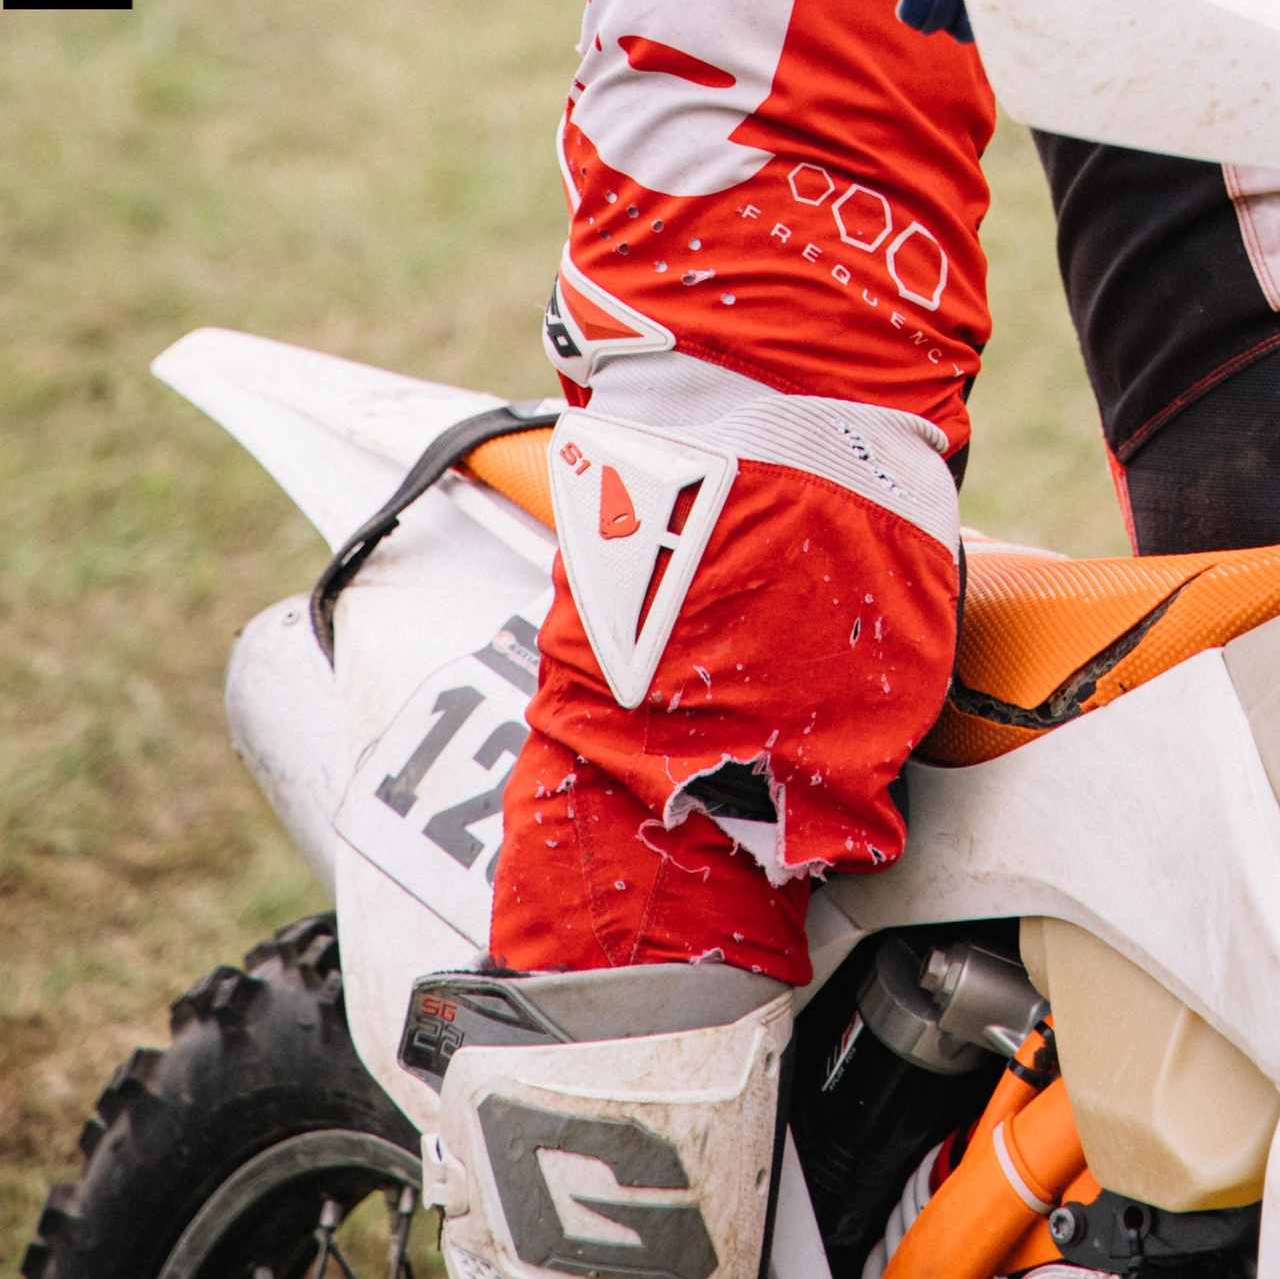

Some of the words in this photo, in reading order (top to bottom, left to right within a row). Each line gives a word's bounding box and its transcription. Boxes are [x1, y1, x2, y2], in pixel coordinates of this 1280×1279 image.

[741, 203, 965, 378] FREQUENCY
[560, 442, 592, 477] S1
[374, 685, 535, 888] 12
[420, 994, 458, 1023] SG
